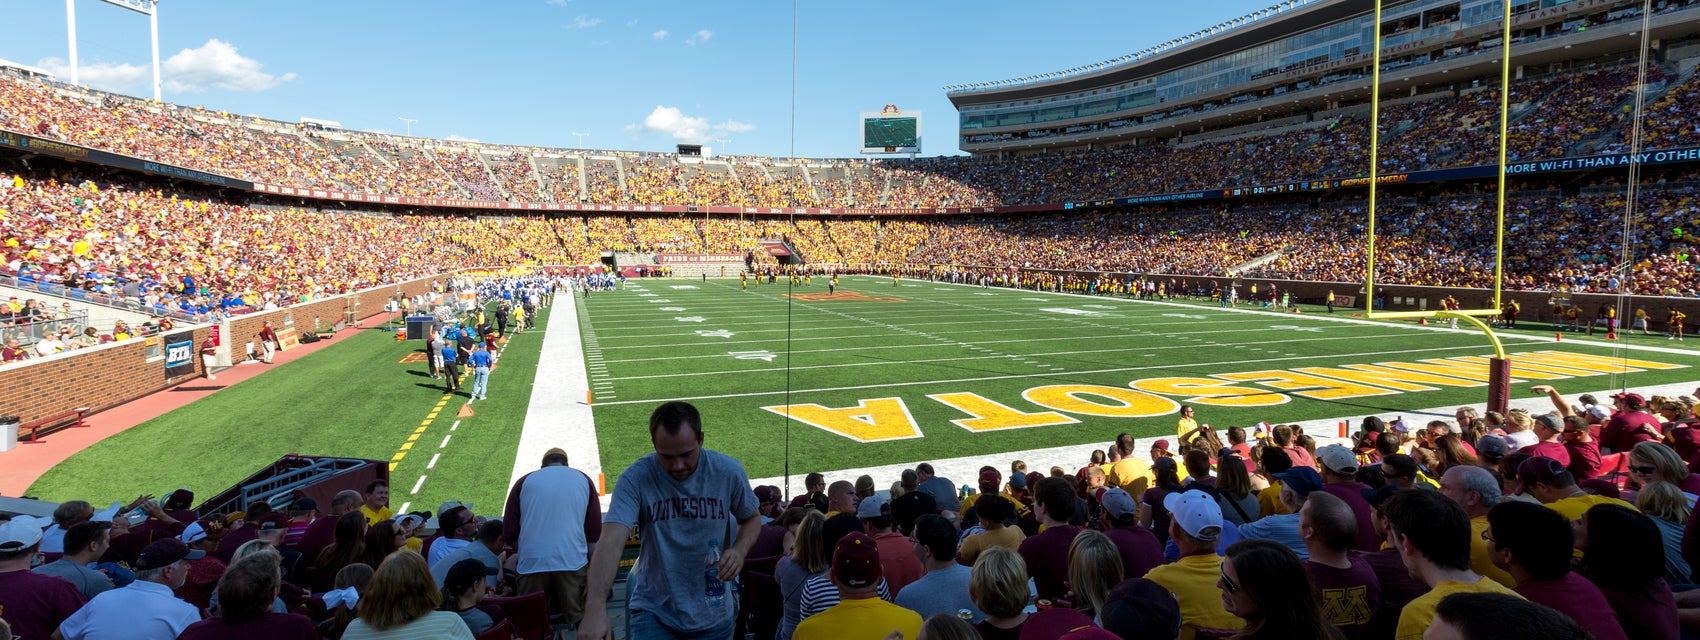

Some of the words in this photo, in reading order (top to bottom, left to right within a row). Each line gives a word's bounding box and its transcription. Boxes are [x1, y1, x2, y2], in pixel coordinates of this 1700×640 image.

[1496, 16, 1520, 28] TF
[1531, 7, 1568, 19] BANK
[1286, 60, 1341, 78] UNIVERSITY
[1362, 40, 1425, 59] MINESOTA
[1504, 163, 1537, 174] MORE
[1540, 160, 1573, 171] WI-FI
[1576, 156, 1615, 168] THAN
[1619, 153, 1651, 165] ANY
[1654, 148, 1700, 162] OTHE
[441, 199, 500, 207] CHAMPIONSHIPS
[762, 350, 1692, 443] MINNESOTA
[647, 497, 726, 524] MINNESOTA
